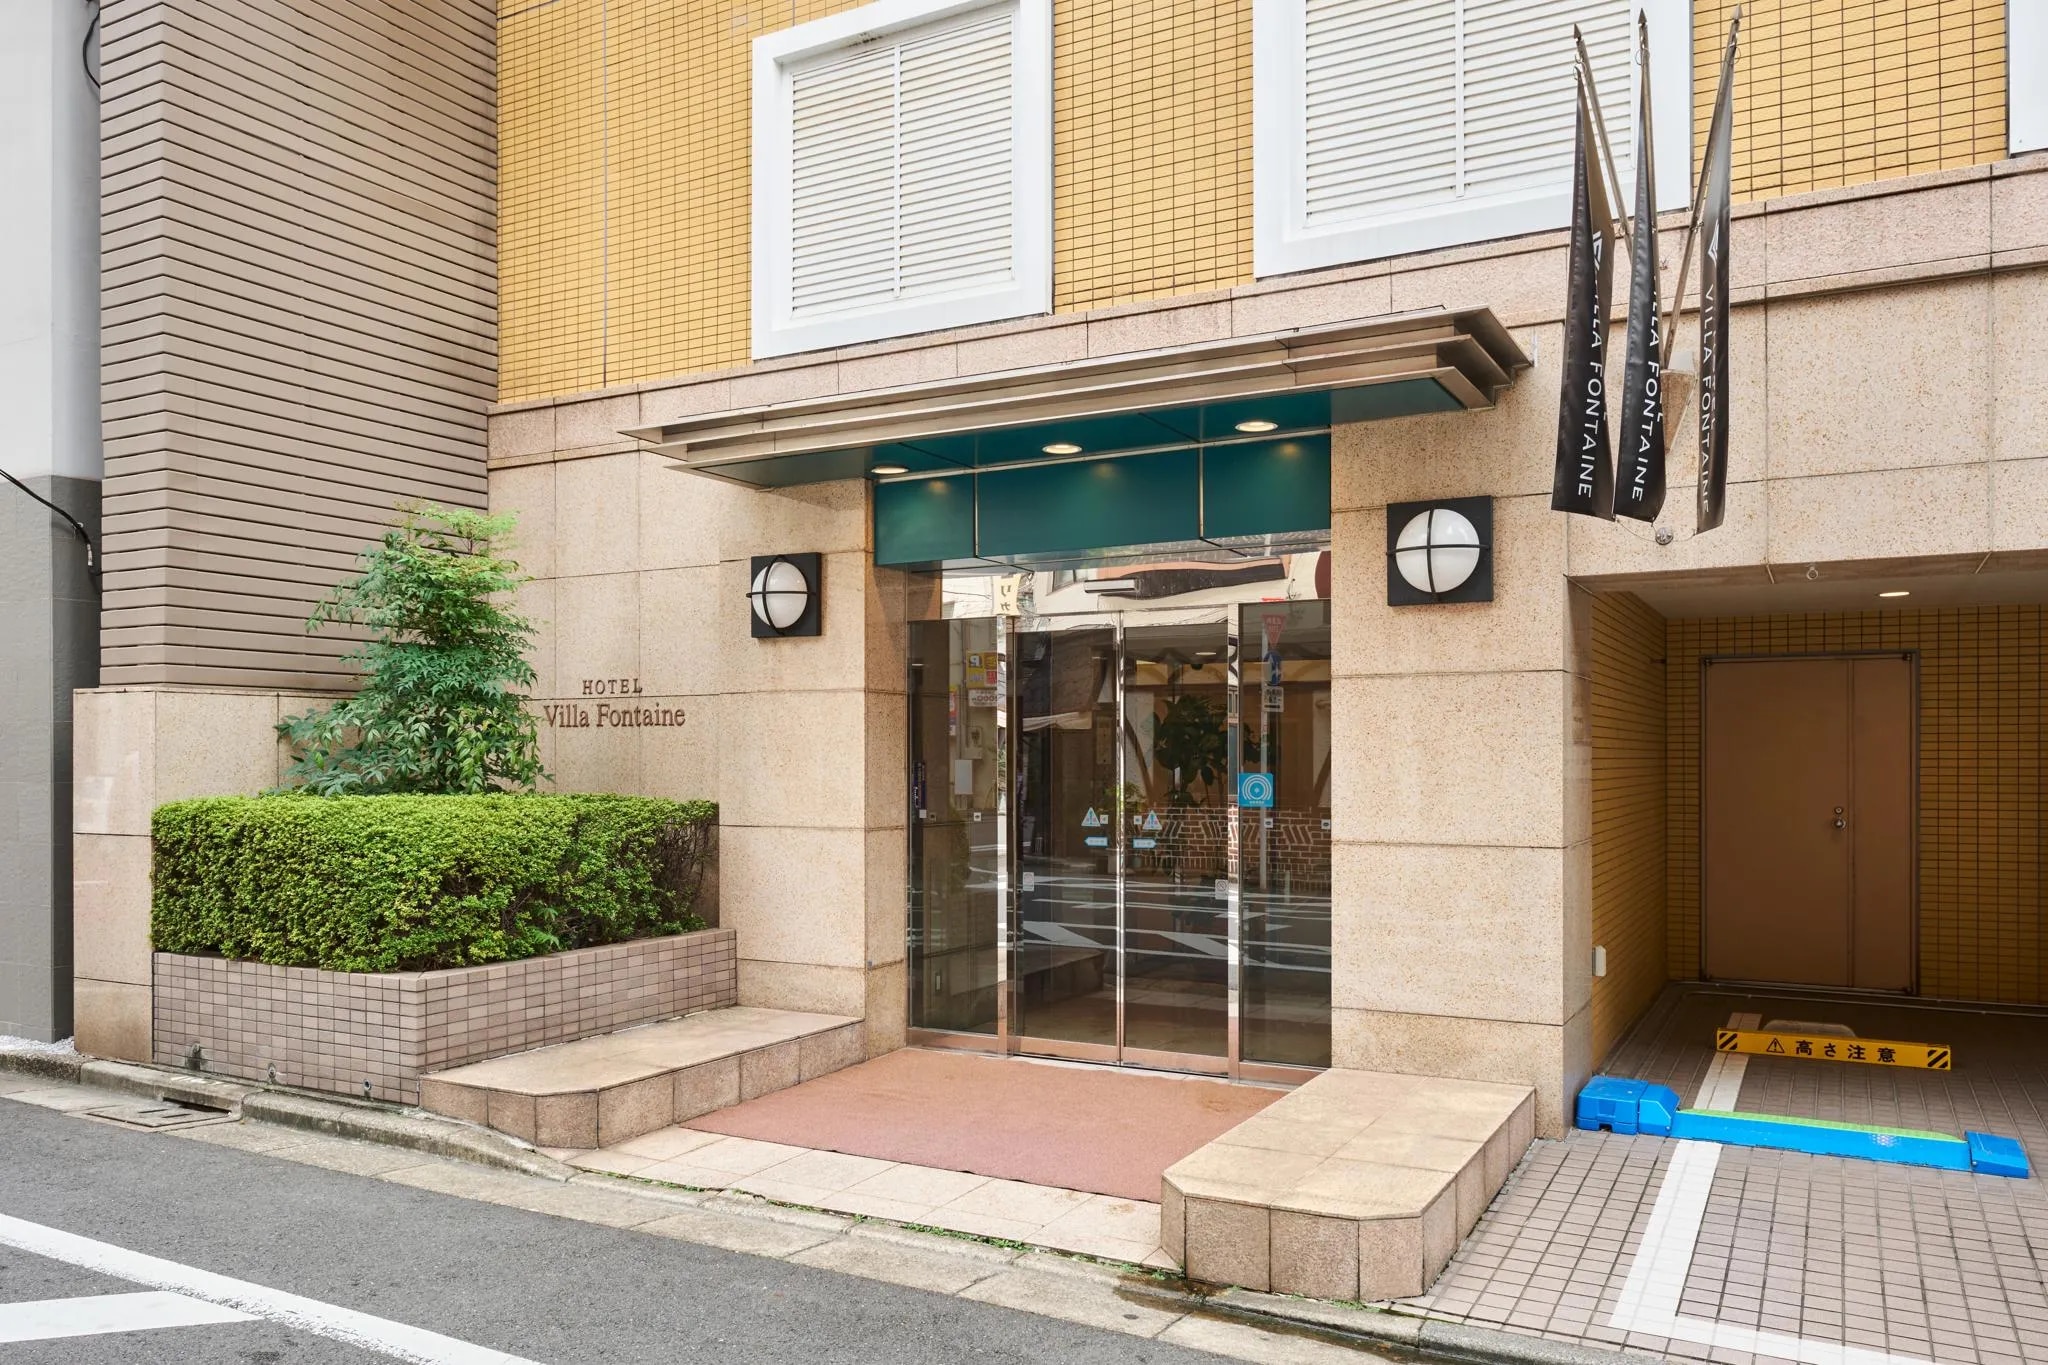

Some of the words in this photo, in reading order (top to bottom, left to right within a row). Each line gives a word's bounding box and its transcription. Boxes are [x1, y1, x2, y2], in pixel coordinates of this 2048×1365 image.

[1702, 283, 1714, 365] VILLA
[1577, 360, 1604, 499] FONTAINE
[1631, 360, 1660, 502] FONTAINE
[582, 678, 643, 695] HOTEL
[543, 703, 590, 728] Villa
[596, 702, 686, 728] Fontaine
[1795, 1039, 1896, 1063] 高さ注意
